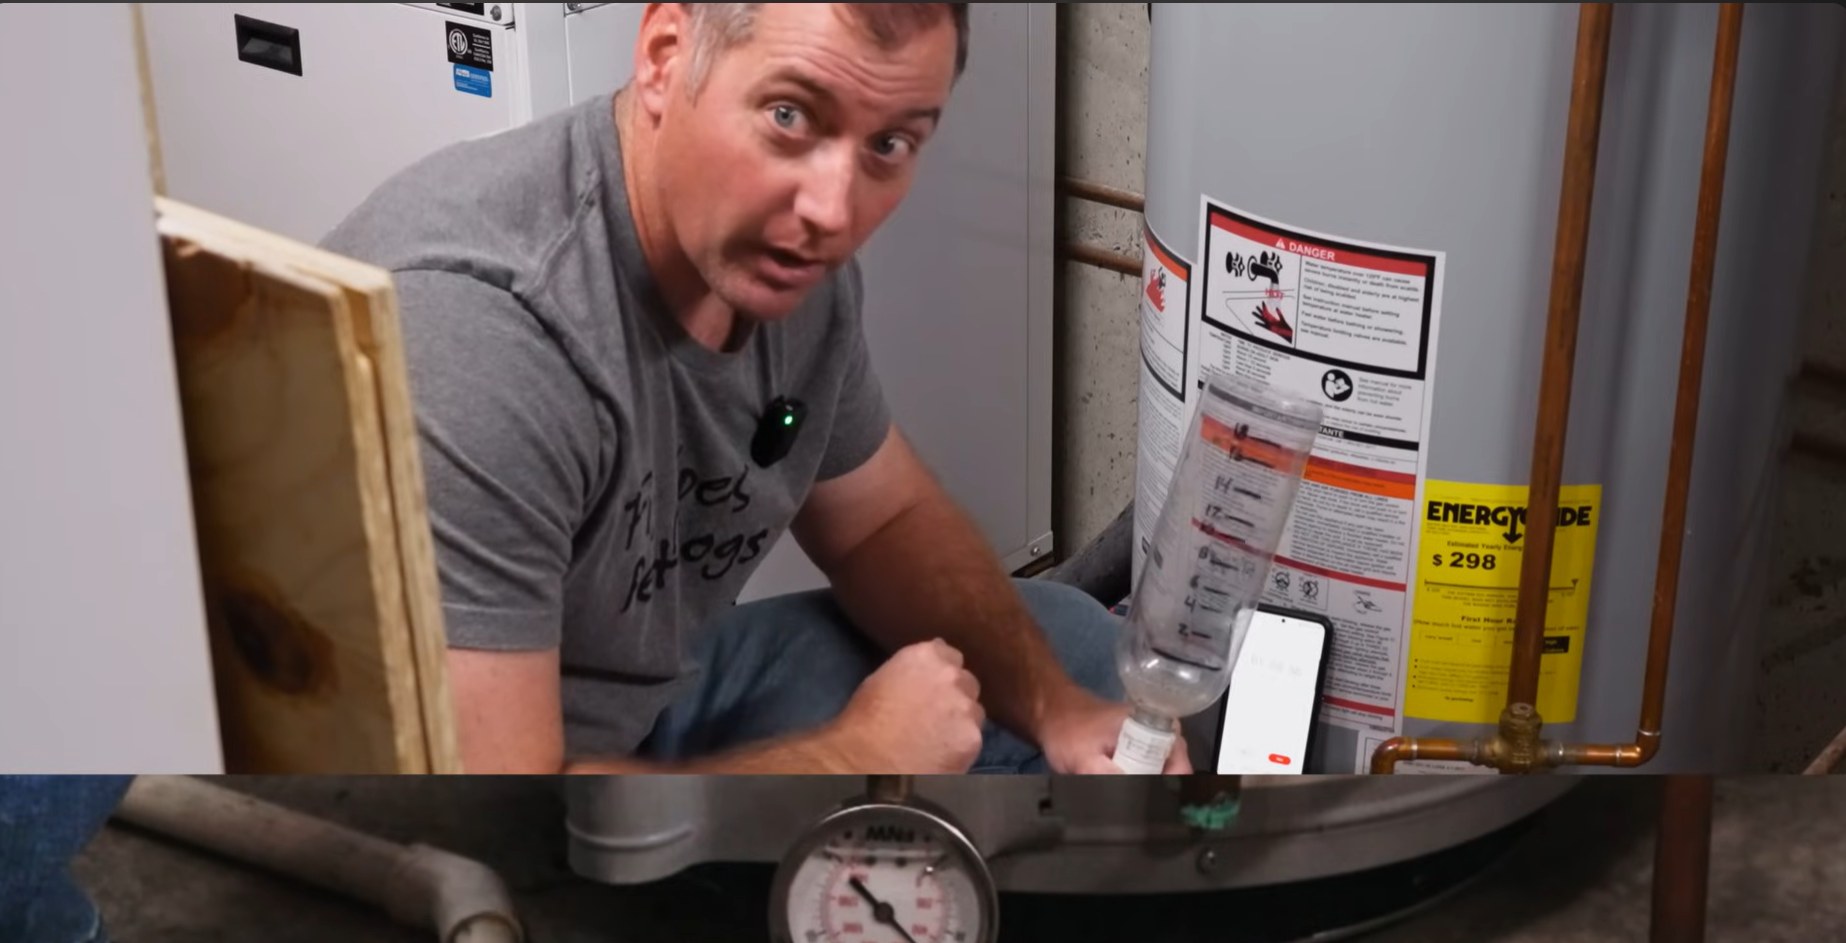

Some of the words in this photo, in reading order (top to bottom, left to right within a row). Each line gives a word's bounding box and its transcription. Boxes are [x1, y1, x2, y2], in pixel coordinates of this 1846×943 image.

[1289, 242, 1336, 262] DANGER
[1214, 475, 1233, 494] 14
[1205, 503, 1222, 519] 12
[1481, 542, 1501, 551] Yearly
[1432, 553, 1442, 567] $
[1449, 551, 1496, 570] 298
[1184, 595, 1196, 612] 4
[1178, 623, 1189, 637] 2
